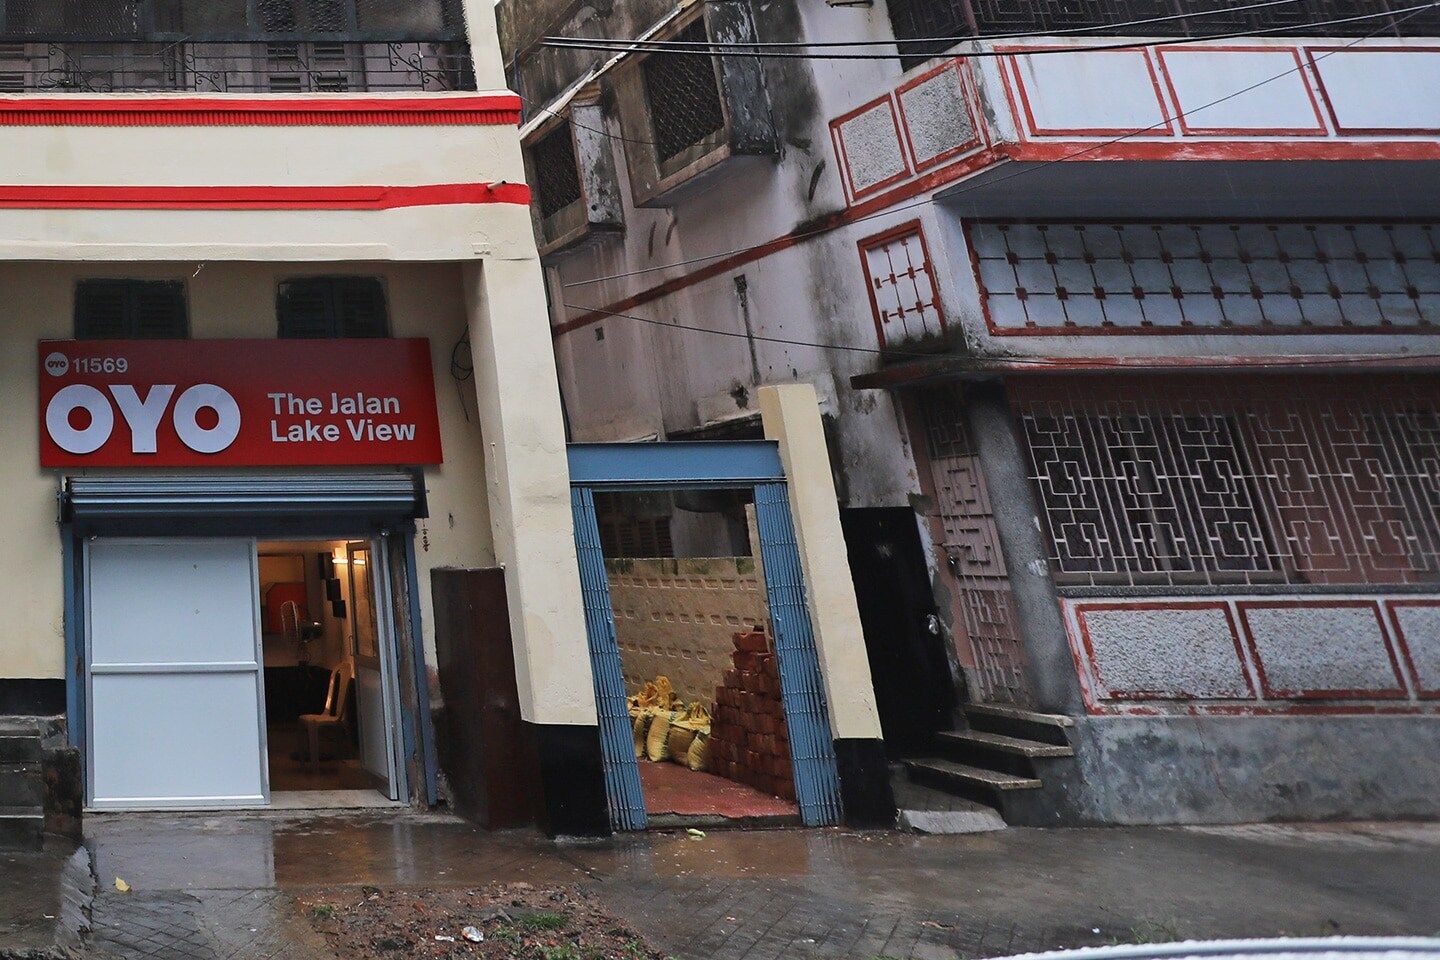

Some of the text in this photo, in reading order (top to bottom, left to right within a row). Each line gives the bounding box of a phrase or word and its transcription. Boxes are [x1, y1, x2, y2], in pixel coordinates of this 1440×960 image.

[47, 357, 129, 374] OYO 11569
[267, 392, 400, 415] The Jalan
[45, 383, 242, 454] OYO
[270, 419, 416, 442] Lake View
